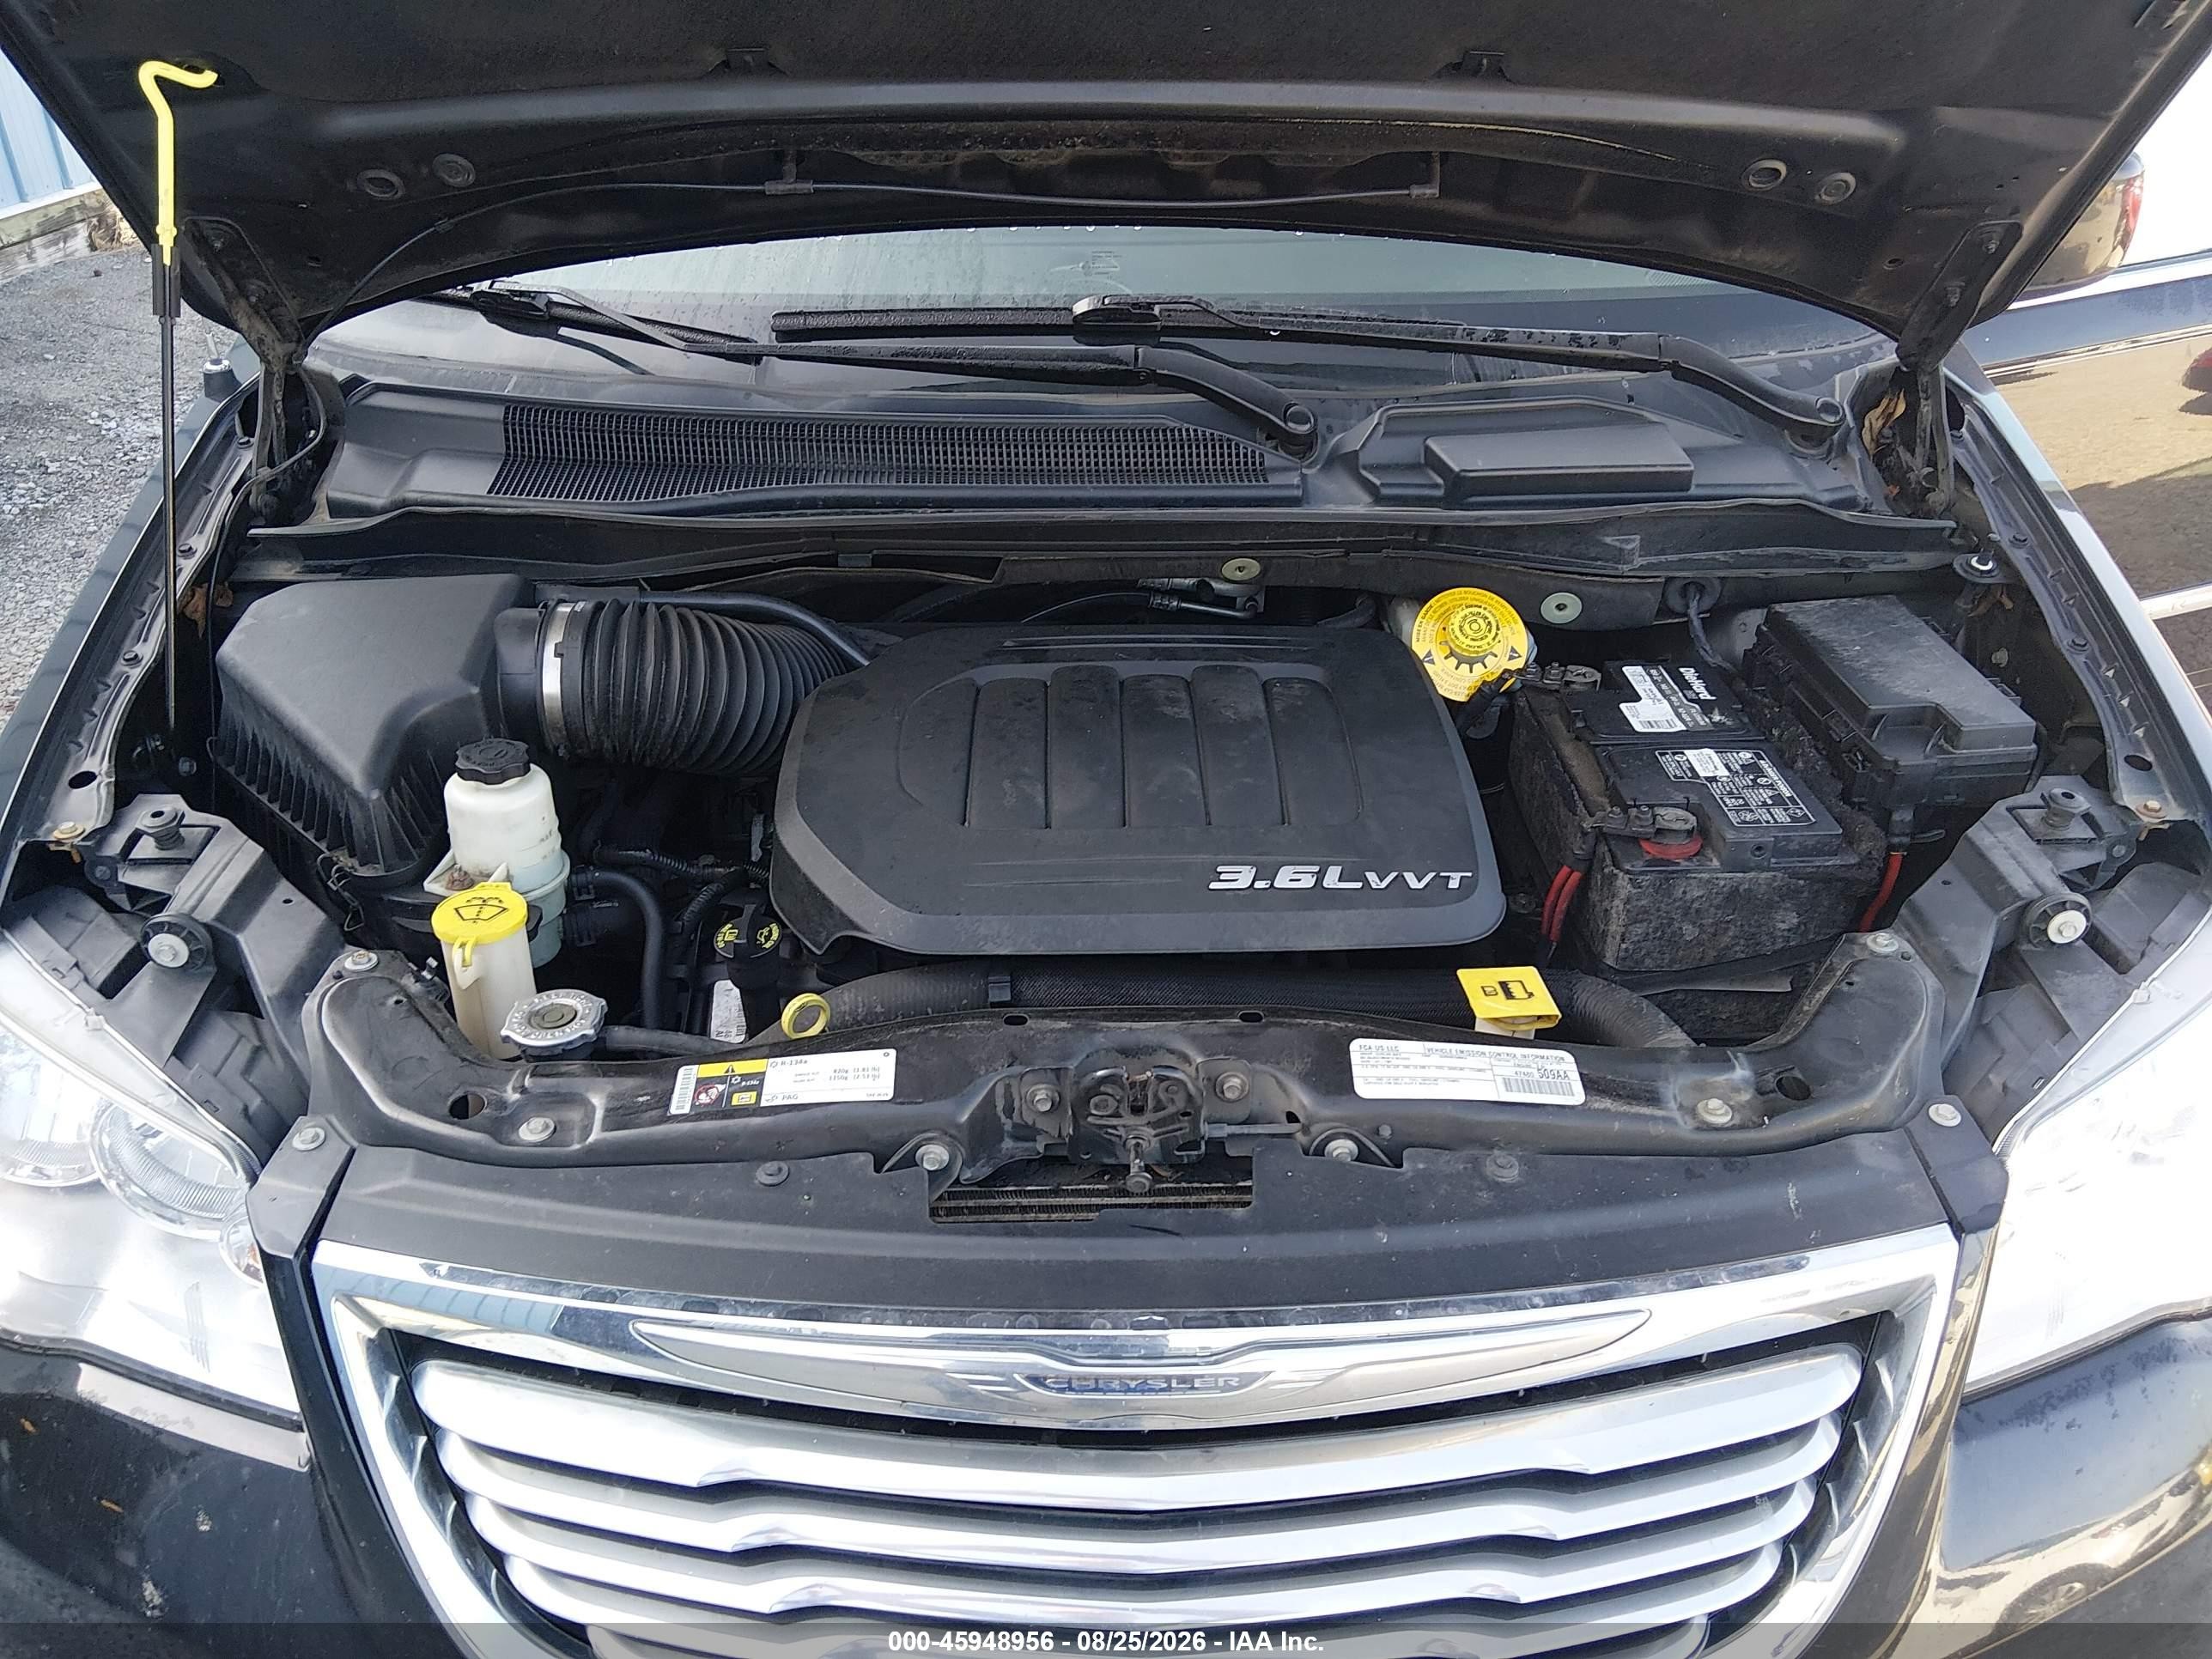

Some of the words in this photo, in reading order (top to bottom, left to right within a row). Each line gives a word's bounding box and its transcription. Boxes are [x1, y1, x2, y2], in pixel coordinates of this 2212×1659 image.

[1679, 667, 1717, 700] DieHard
[1364, 871, 1473, 889] VVT
[1488, 1051, 1518, 1060] CONTROL
[1520, 1054, 1565, 1062] INFORMATION
[1047, 1375, 1241, 1390] CHRYSLER
